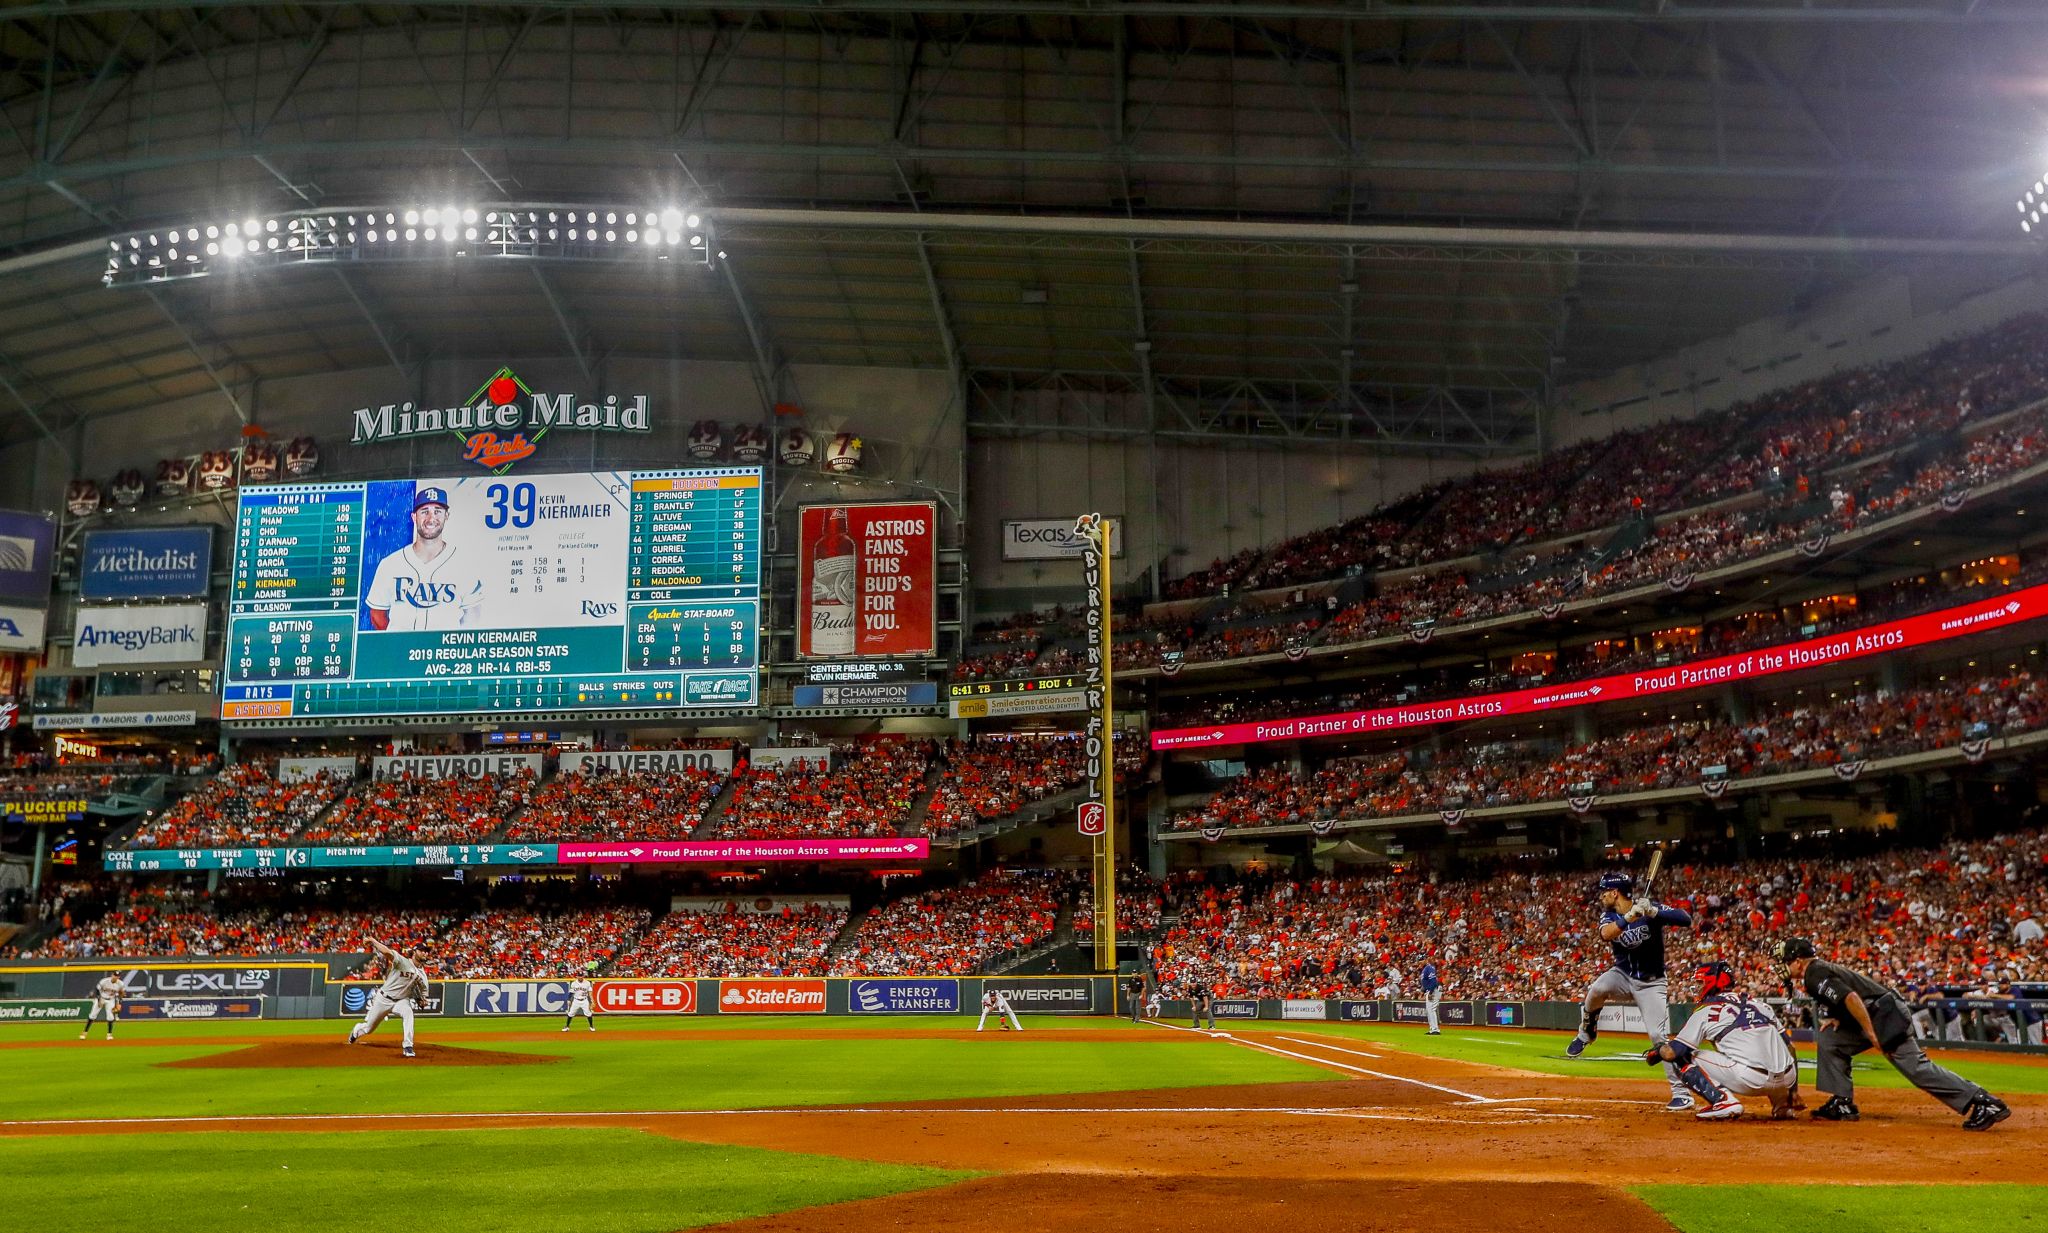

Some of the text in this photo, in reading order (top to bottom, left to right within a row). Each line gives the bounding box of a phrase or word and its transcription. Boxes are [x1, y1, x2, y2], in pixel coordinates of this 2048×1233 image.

[351, 392, 651, 446] Minute Maid
[464, 431, 536, 467] Park
[837, 432, 851, 455] 7
[539, 495, 566, 505] KEVIN
[654, 492, 694, 500] SPRINGER
[261, 506, 299, 515] MEADOWS
[484, 482, 537, 529] 39
[654, 502, 694, 510] BRANTLEY
[539, 504, 611, 520] KIERMAIER
[652, 513, 682, 521] ALTUVE
[260, 517, 282, 526] PHAM
[260, 528, 277, 536] CHOI
[652, 523, 692, 532] BREGMAN
[865, 519, 926, 537] ASTROS
[652, 534, 686, 542] ALVAREZ
[1010, 524, 1066, 543] Texas
[258, 537, 298, 546] D'ARNAUD
[865, 538, 908, 556] FANS,
[652, 545, 686, 554] GURRIEL
[92, 549, 198, 573] Methodist
[652, 556, 683, 564] CORREA
[652, 566, 686, 575] REDDICK
[864, 558, 900, 574] THIS
[119, 572, 196, 582] LEADING MEDICINE
[256, 569, 288, 578] WENDLE
[256, 579, 297, 588] KIERMAIER
[651, 576, 702, 586] MALDONADO
[864, 576, 912, 592] BUD'S
[254, 590, 286, 599] ADAMES
[393, 576, 457, 609] RAYS
[650, 590, 671, 599] COLE
[254, 603, 292, 612] GLASNOW
[580, 599, 617, 618] RAYS
[864, 595, 894, 611] FOR
[648, 608, 735, 621] Apache STAT-BOARD
[268, 620, 313, 632] BATTING
[864, 614, 900, 630] YOU.
[638, 624, 656, 633] ERA
[78, 624, 196, 650] AmegyBank
[300, 634, 310, 643] 3B
[442, 631, 537, 645] KEVIN KIERMAIER
[408, 644, 568, 661] 2019 REGULAR SEASON STATS
[269, 656, 341, 666] SB OBP SLG
[1635, 630, 1904, 692] Proud Partner of the Houston Astros
[424, 660, 551, 676] AVG-.228 HR-14 RBI-55
[810, 664, 842, 673] CENTER
[843, 664, 878, 673] FIELDER,
[894, 664, 905, 672] 39,
[810, 672, 879, 681] KEVIN KIERMAIER.
[578, 681, 674, 692] BALLS STRIKES OUTS
[841, 686, 908, 698] CHAMPION
[952, 680, 1060, 695] 6:41 HOU
[246, 686, 273, 699] RAYS
[873, 696, 908, 704] SERVICES
[992, 696, 1080, 708] SmileGeneration.com
[234, 704, 281, 716] ASTROS
[960, 702, 986, 713] smile
[50, 717, 84, 726] NABORS
[102, 716, 138, 724] NABORS
[155, 714, 191, 723] NABORS
[1256, 699, 1503, 740] Proud Partner of the Houston Astros
[1184, 734, 1212, 744] AMERICA
[390, 756, 527, 780] CHEVROLET
[580, 754, 714, 776] SILVERADO
[5, 800, 88, 814] PLUCKERS
[25, 813, 67, 823] WING BAR
[108, 850, 276, 862] COLE BALLS STRIKES TOTAL
[326, 848, 366, 856] PITCH TYPE
[652, 846, 830, 858] Proud Partner of the Houston Astros
[416, 858, 454, 866] REMAINING
[246, 970, 270, 980] 373
[157, 973, 264, 990] LEXUS
[469, 983, 565, 1013] RTIC
[890, 987, 938, 998] ENERGY
[987, 990, 1085, 1000] OWERADE
[177, 1002, 218, 1013] Germania
[890, 998, 952, 1009] TRANSFER
[28, 1007, 80, 1017] Car Rental
[1350, 1004, 1371, 1018] @MLB
